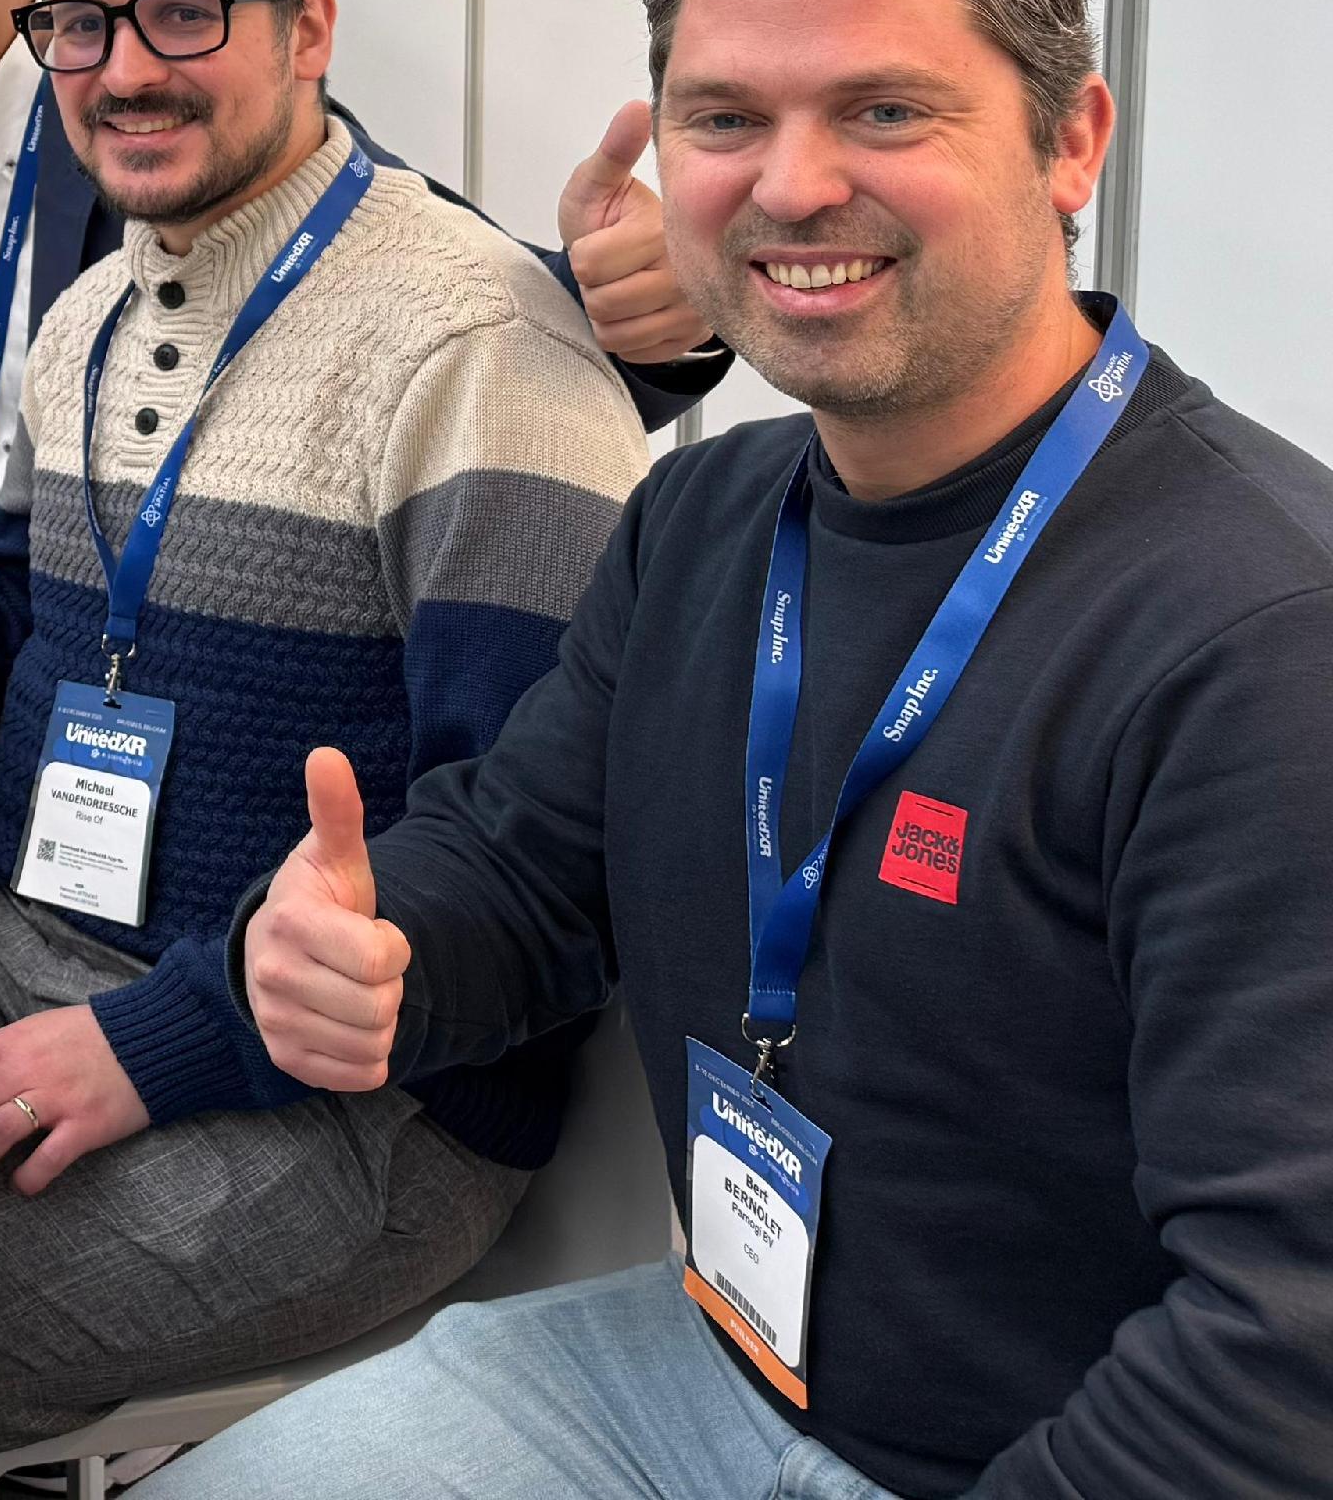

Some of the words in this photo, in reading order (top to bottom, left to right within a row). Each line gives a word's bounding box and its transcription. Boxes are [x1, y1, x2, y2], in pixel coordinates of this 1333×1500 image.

[271, 232, 313, 282] UnitedXR
[1111, 351, 1133, 382] SPATIAL
[984, 490, 1040, 564] UnitedXR
[771, 590, 791, 635] Snap
[771, 634, 788, 664] Inc.
[883, 697, 923, 743] Snap
[906, 668, 939, 704] Inc.
[66, 722, 147, 756] UnitedXR
[52, 789, 138, 817] VANDENDRIESSCHE
[75, 778, 114, 796] Michael
[758, 776, 773, 857] UnitedXR
[896, 821, 960, 856] Jack&
[892, 839, 957, 874] Jones
[713, 1091, 803, 1184] UnitedXR
[746, 1174, 769, 1204] Bert
[724, 1177, 783, 1240] BERNOLET
[743, 1243, 759, 1264] CEO
